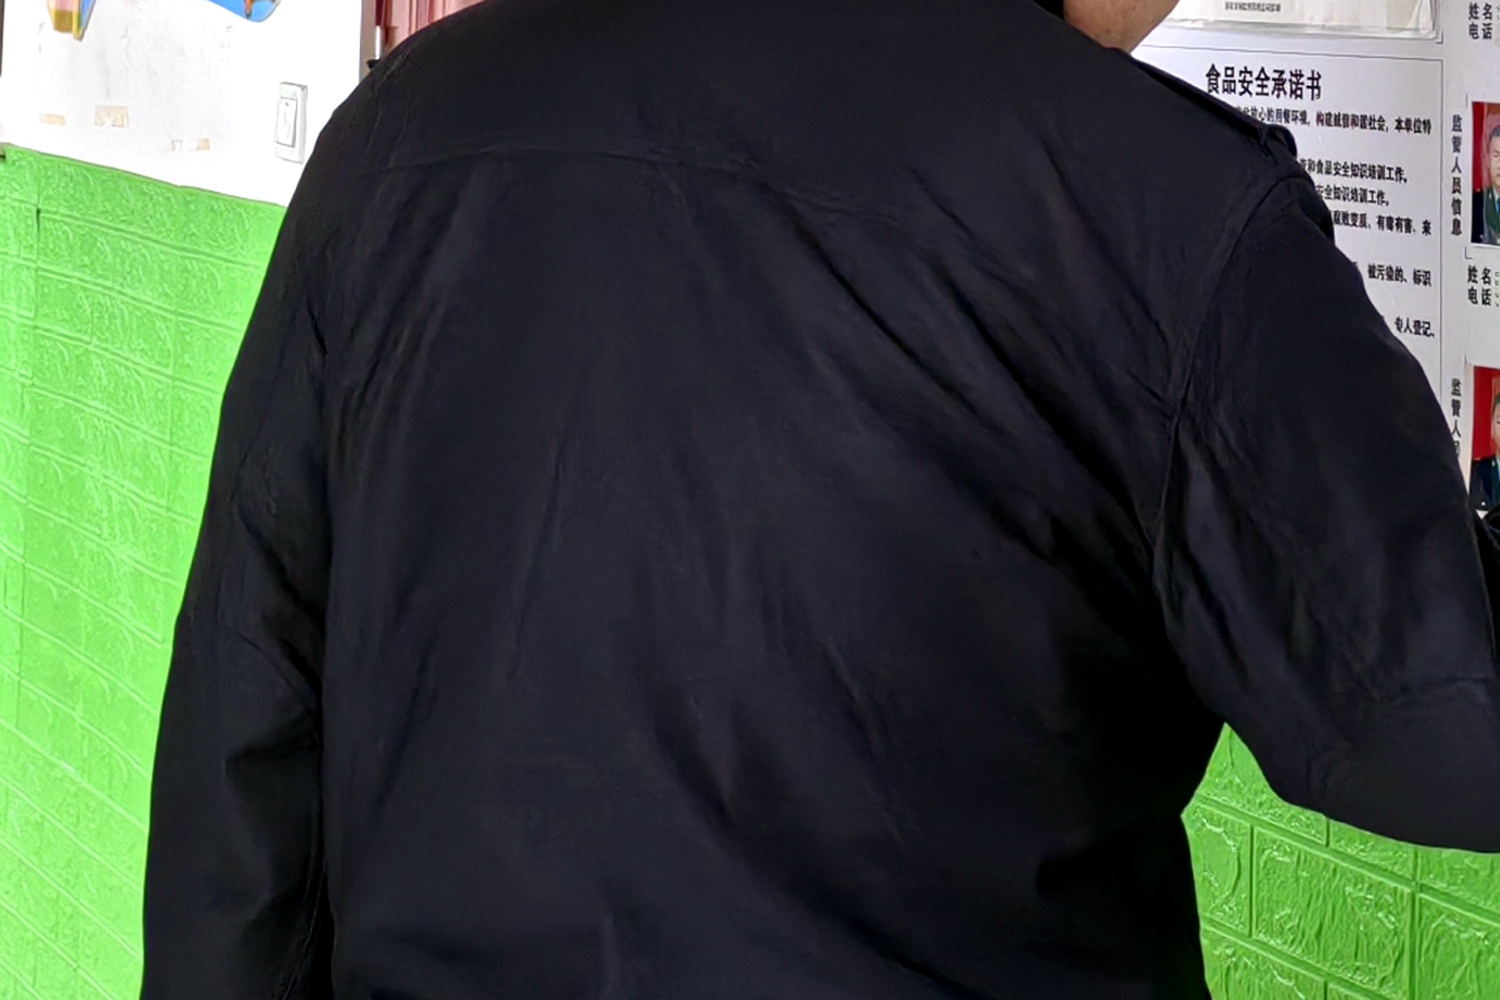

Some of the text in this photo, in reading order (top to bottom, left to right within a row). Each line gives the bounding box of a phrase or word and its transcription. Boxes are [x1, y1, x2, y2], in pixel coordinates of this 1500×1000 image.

[1205, 63, 1322, 101] 食品安全承诺书
[1451, 114, 1463, 236] 监管人员信息
